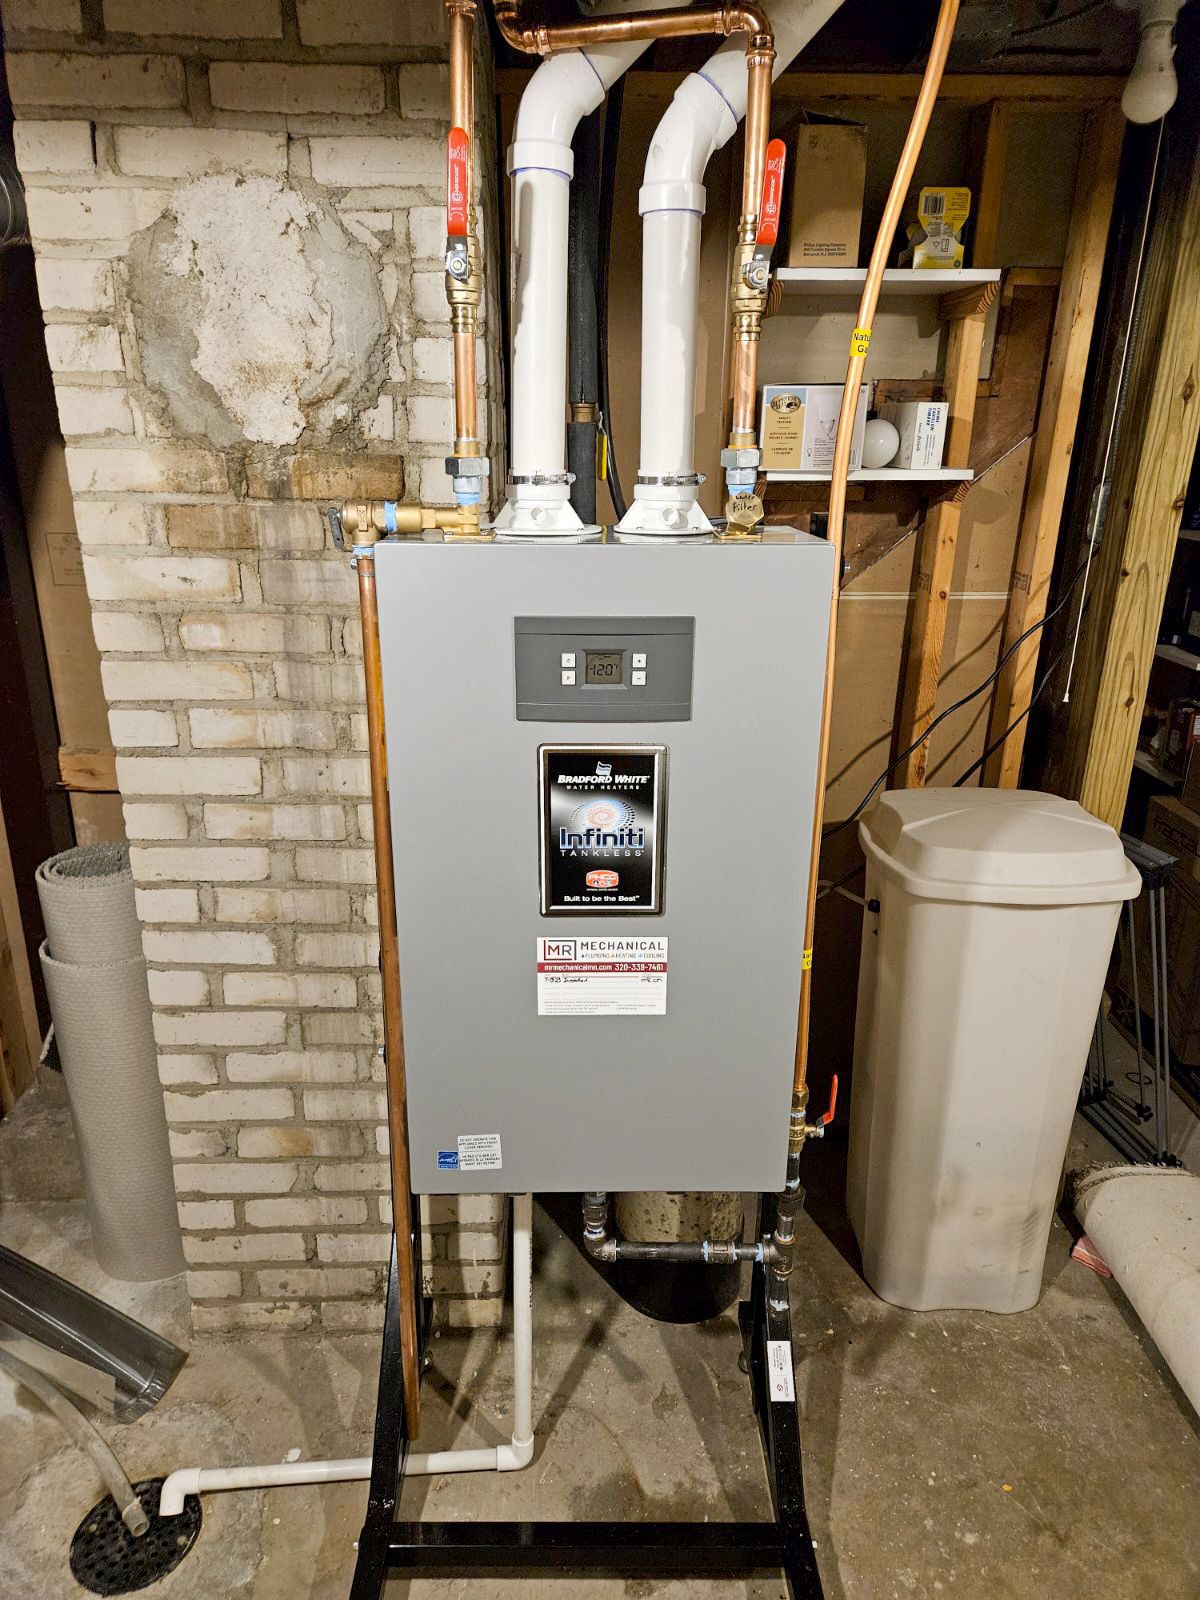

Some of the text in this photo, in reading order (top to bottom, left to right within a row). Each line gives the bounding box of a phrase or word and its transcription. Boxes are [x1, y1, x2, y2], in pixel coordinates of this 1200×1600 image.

[558, 775, 649, 784] BRADFORD WHITE
[560, 827, 645, 849] Infiniti
[548, 941, 664, 955] MR MECHANICAL
